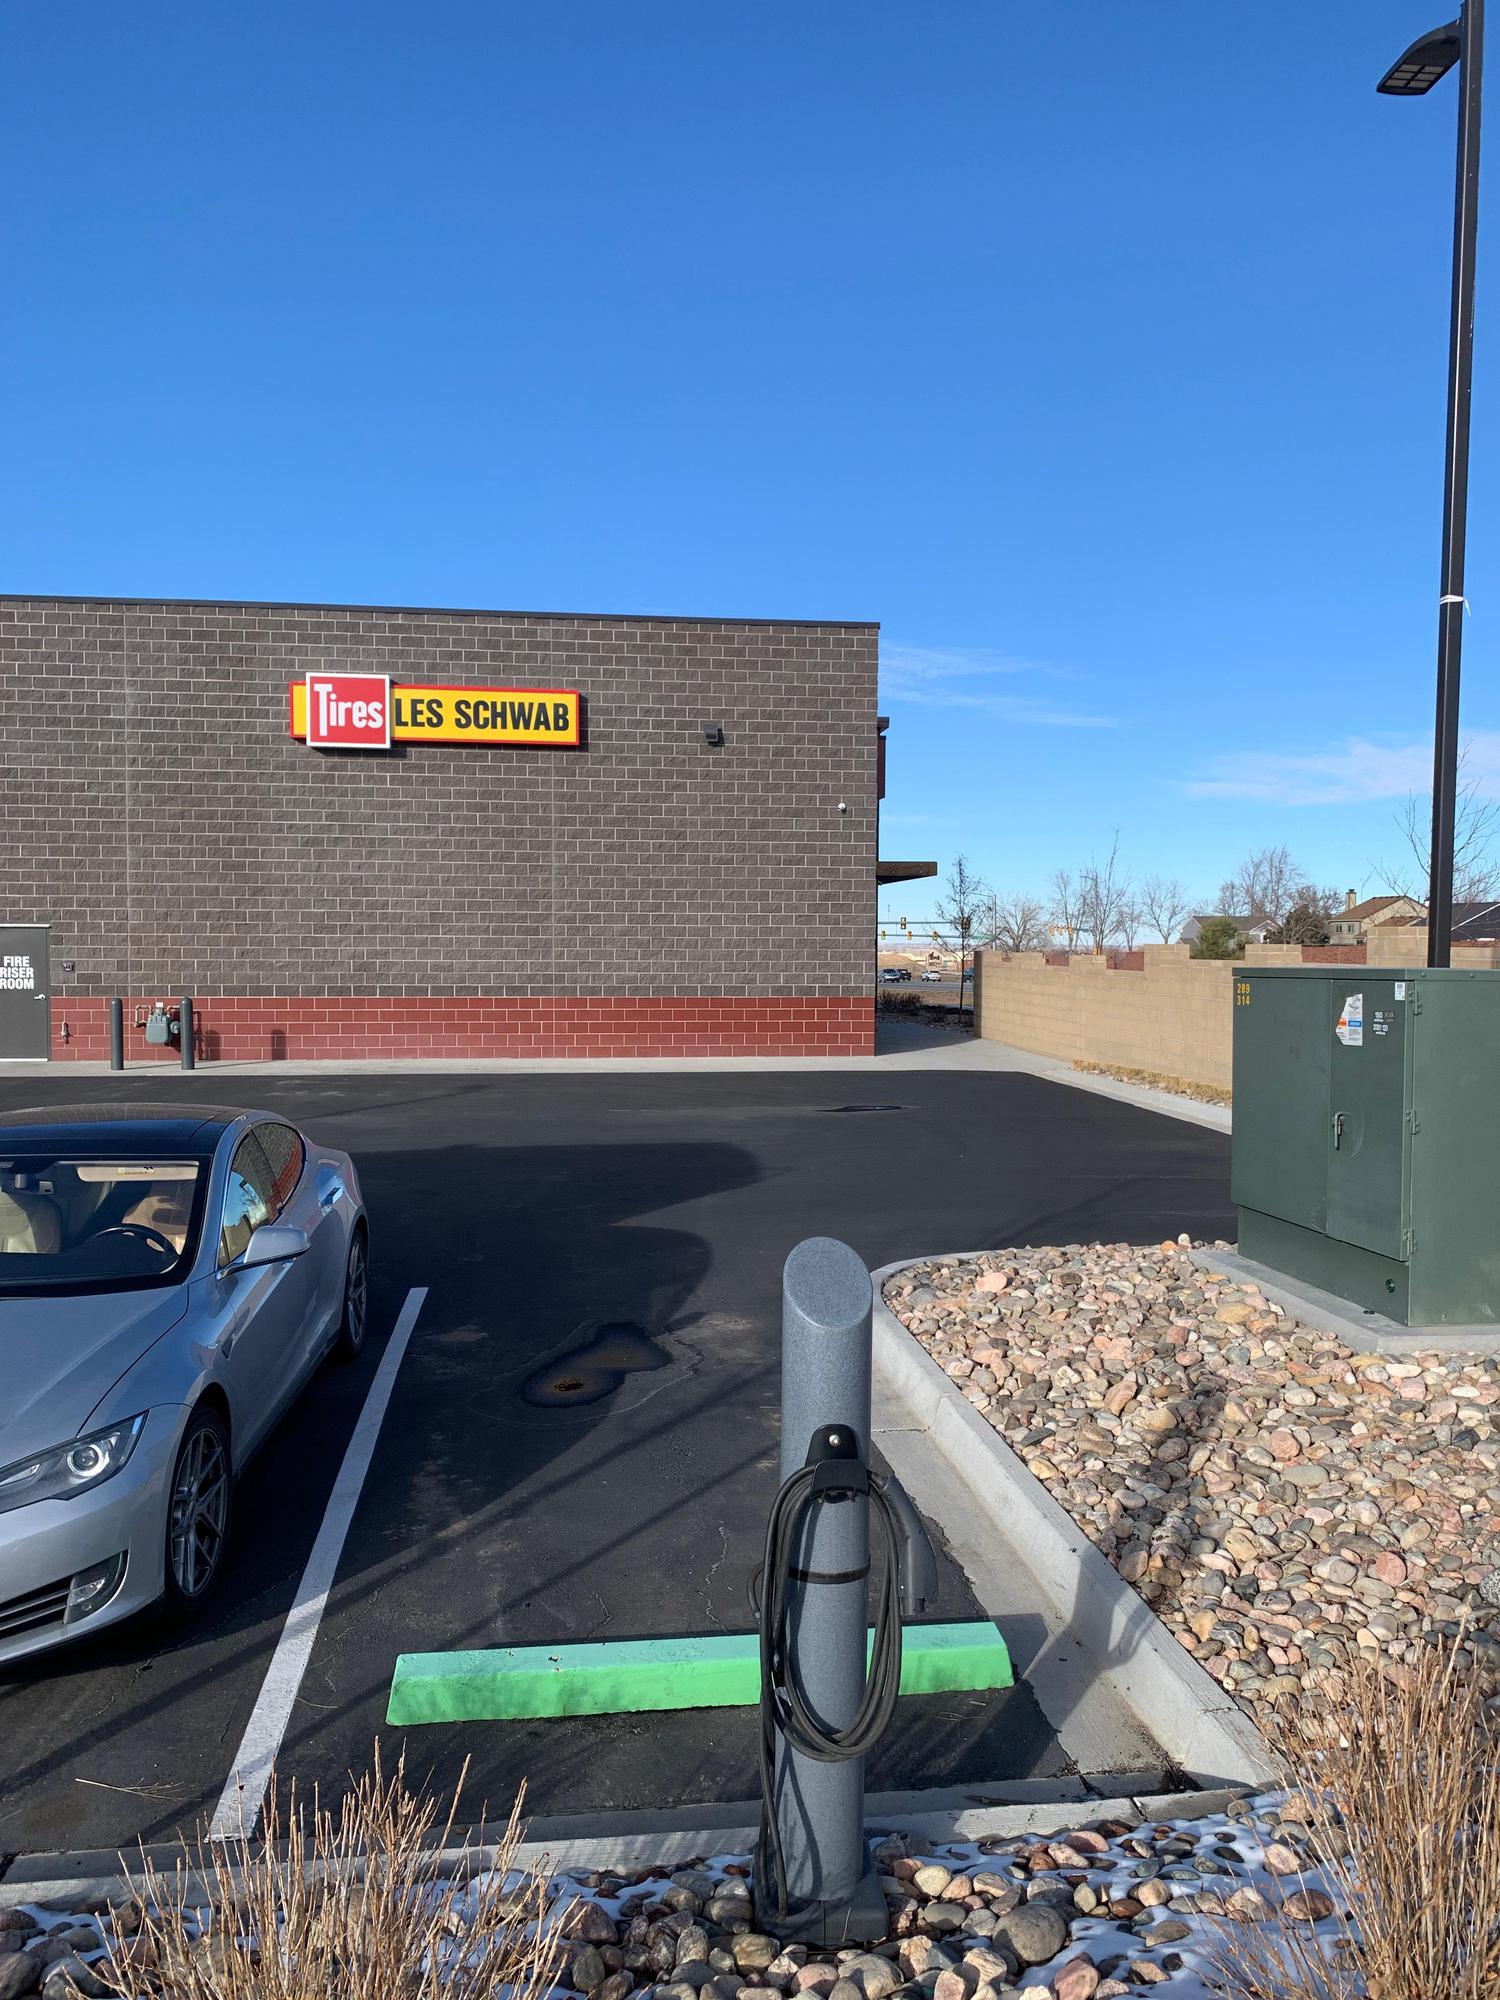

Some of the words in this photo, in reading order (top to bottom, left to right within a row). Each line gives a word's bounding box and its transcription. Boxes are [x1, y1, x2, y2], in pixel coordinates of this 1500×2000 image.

[313, 683, 383, 737] Tires
[395, 698, 444, 728] LES
[454, 700, 569, 732] SCHWAB
[4, 956, 30, 967] FIRE
[0, 967, 34, 978] RISER
[0, 978, 34, 990] ROOM
